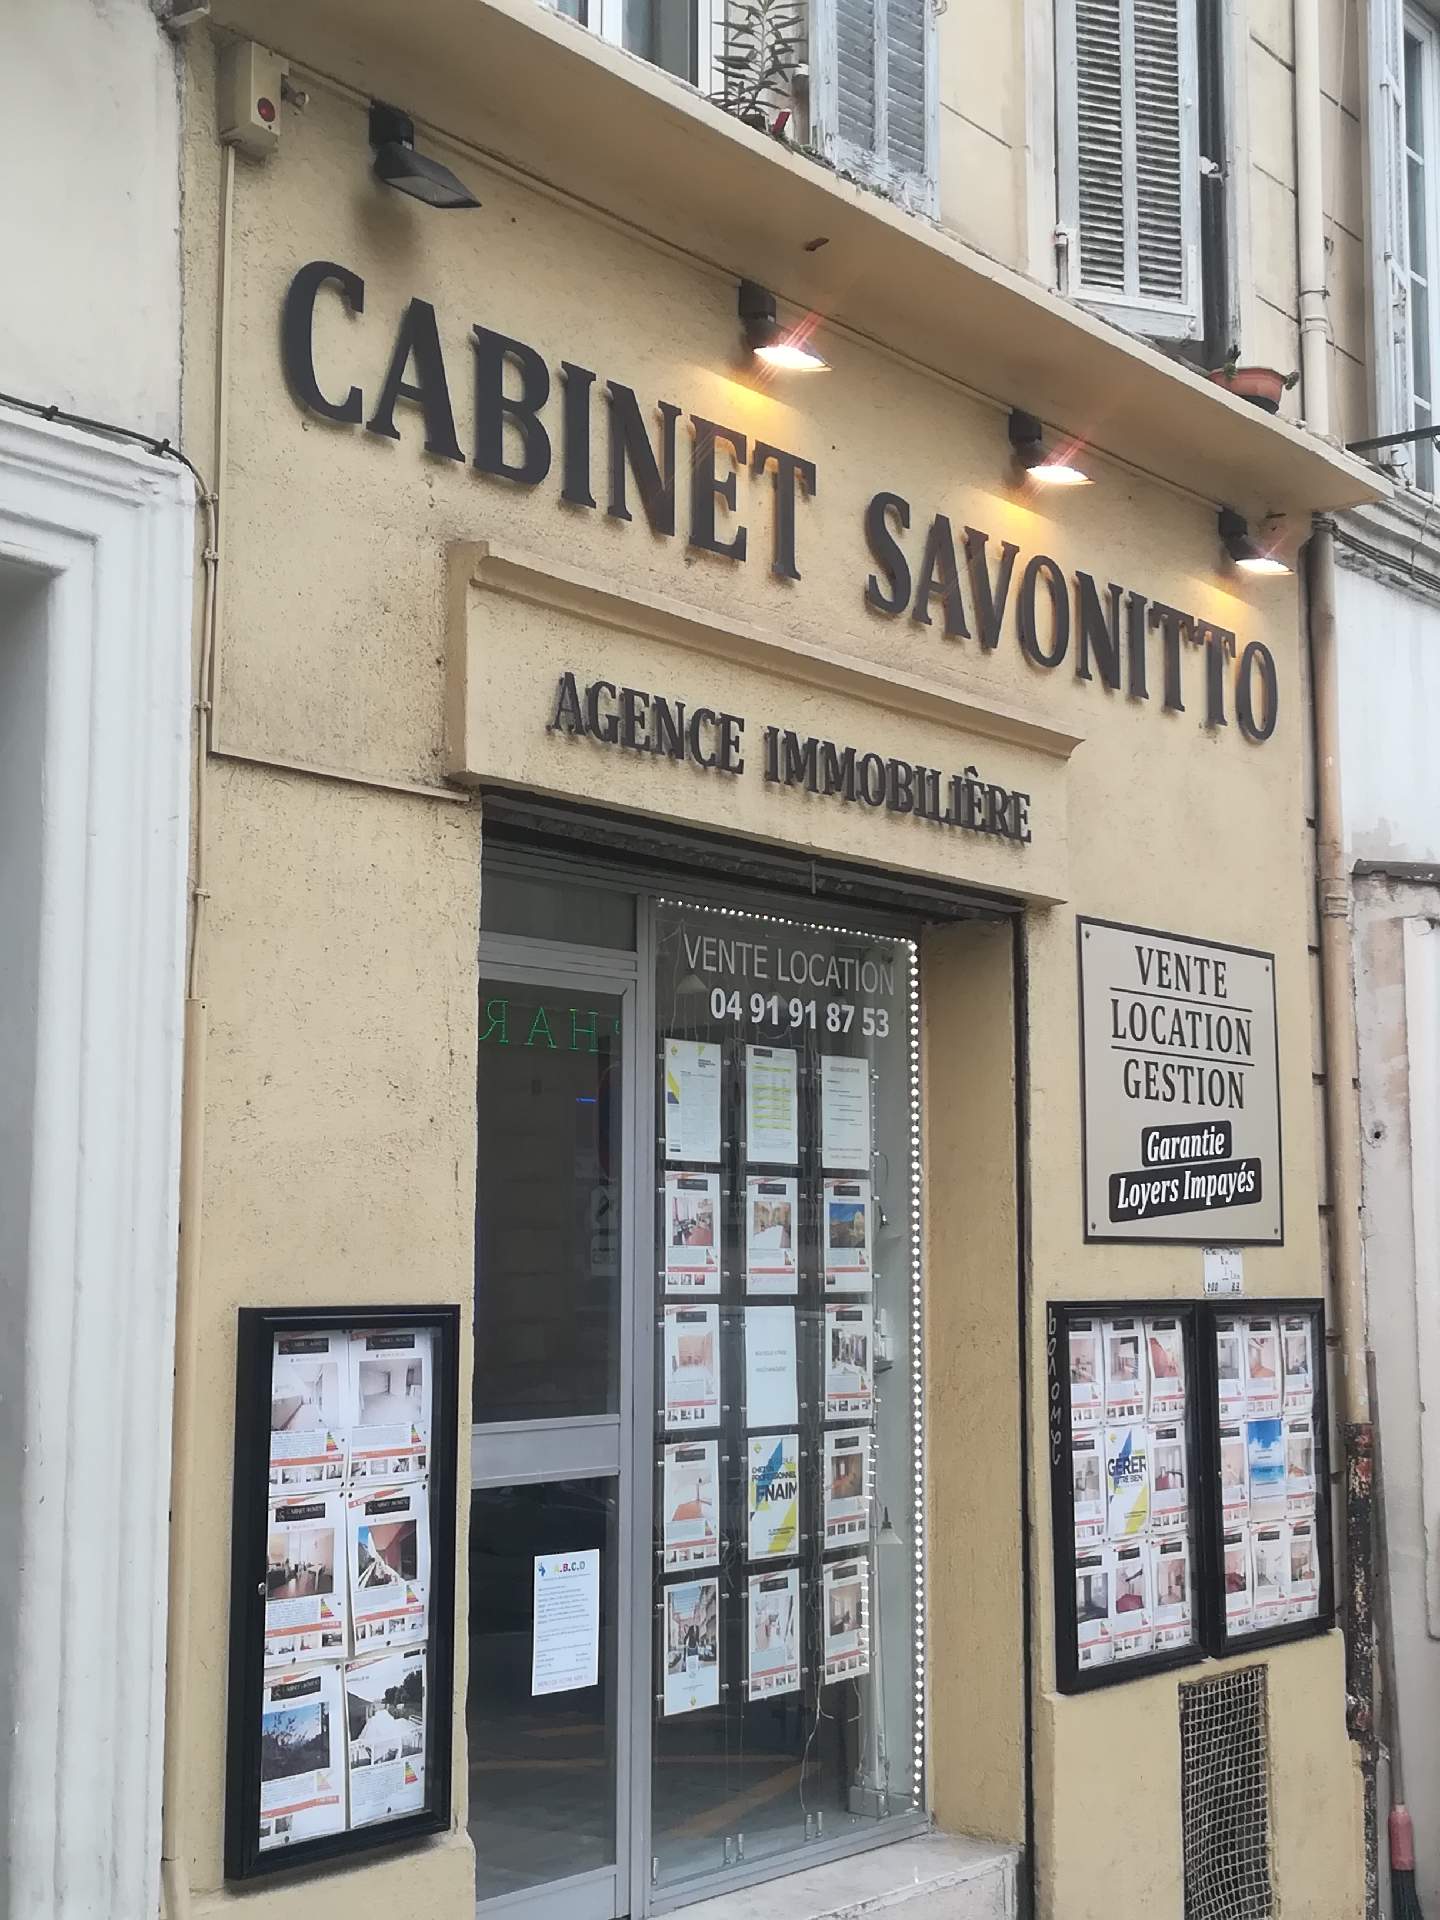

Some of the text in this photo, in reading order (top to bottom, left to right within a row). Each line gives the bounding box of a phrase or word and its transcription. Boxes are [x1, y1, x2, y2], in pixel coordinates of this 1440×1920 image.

[283, 260, 1278, 741] CABINET SAVONITTO
[546, 671, 745, 775] AGENCE
[684, 934, 895, 995] VENTE LOCATION
[1134, 945, 1227, 999] VENTE
[710, 987, 889, 1038] 04 91 91 87 53
[1111, 998, 1252, 1056] LOCATION
[1124, 1058, 1244, 1109] GESTION
[1147, 1125, 1225, 1162] Garantie
[1117, 1162, 1255, 1214] Loyers Impayés
